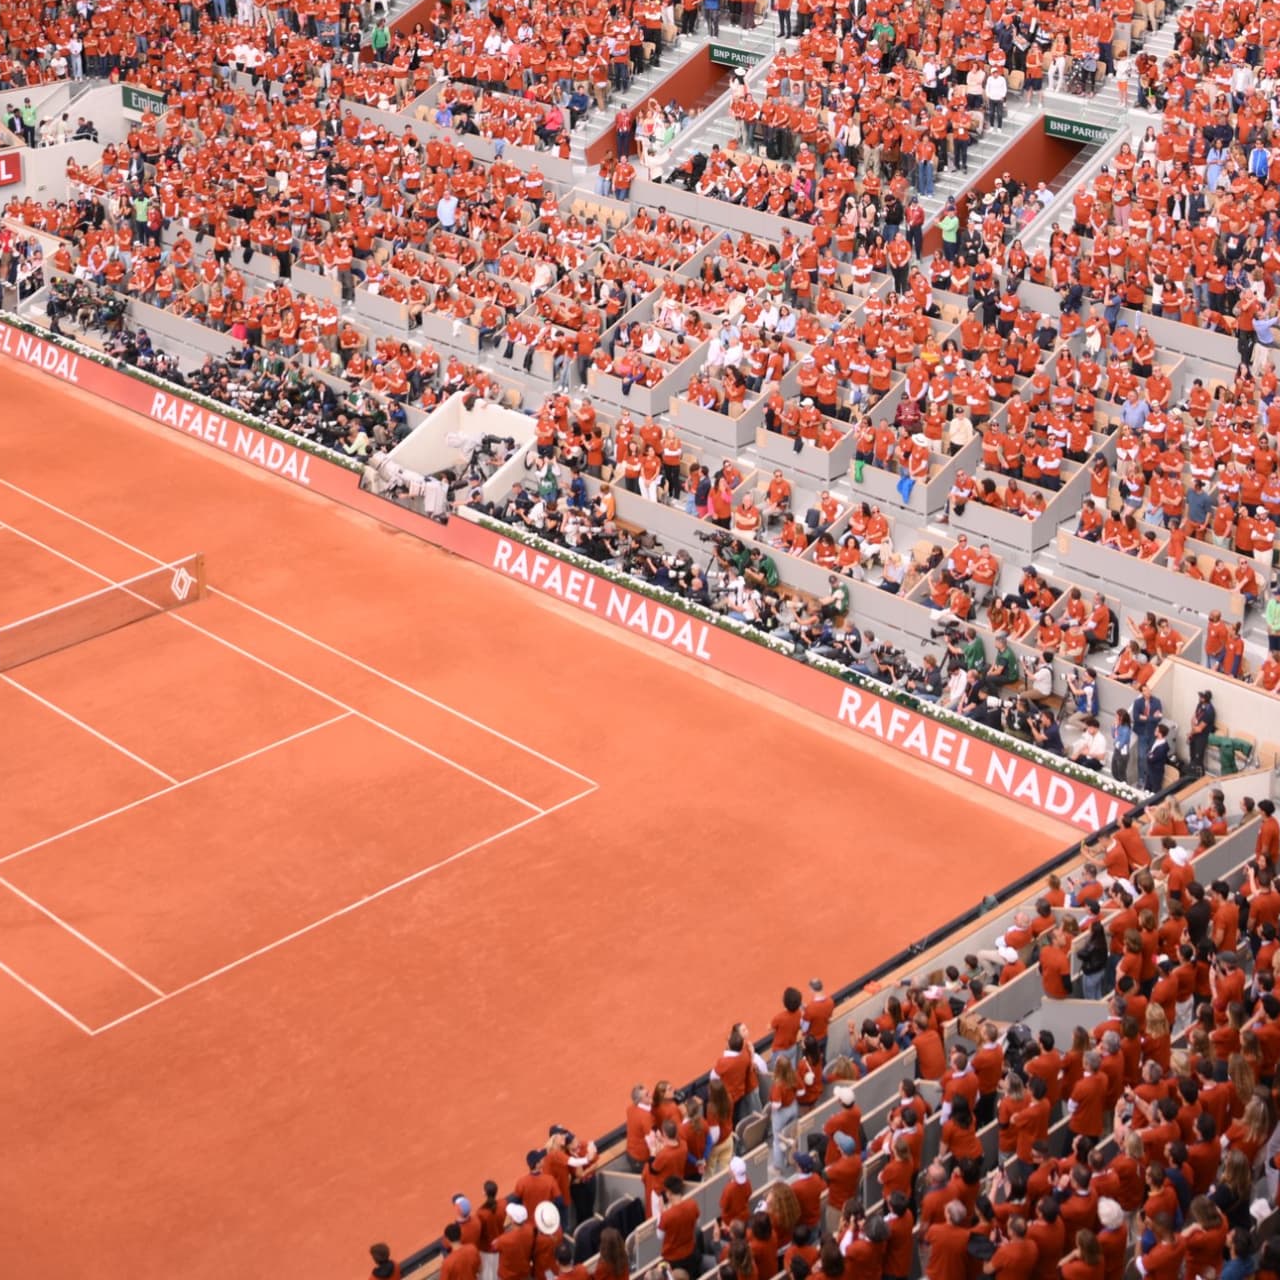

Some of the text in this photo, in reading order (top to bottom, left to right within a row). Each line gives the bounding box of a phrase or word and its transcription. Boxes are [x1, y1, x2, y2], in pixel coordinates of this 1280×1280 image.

[713, 48, 761, 64] BNP PARIBA
[1050, 120, 1071, 133] BNP
[16, 334, 79, 383] NADAL
[151, 392, 312, 485] RAFAEL NADAL
[493, 539, 712, 660] RAFAEL NADAL
[837, 687, 973, 776] RAFAEL
